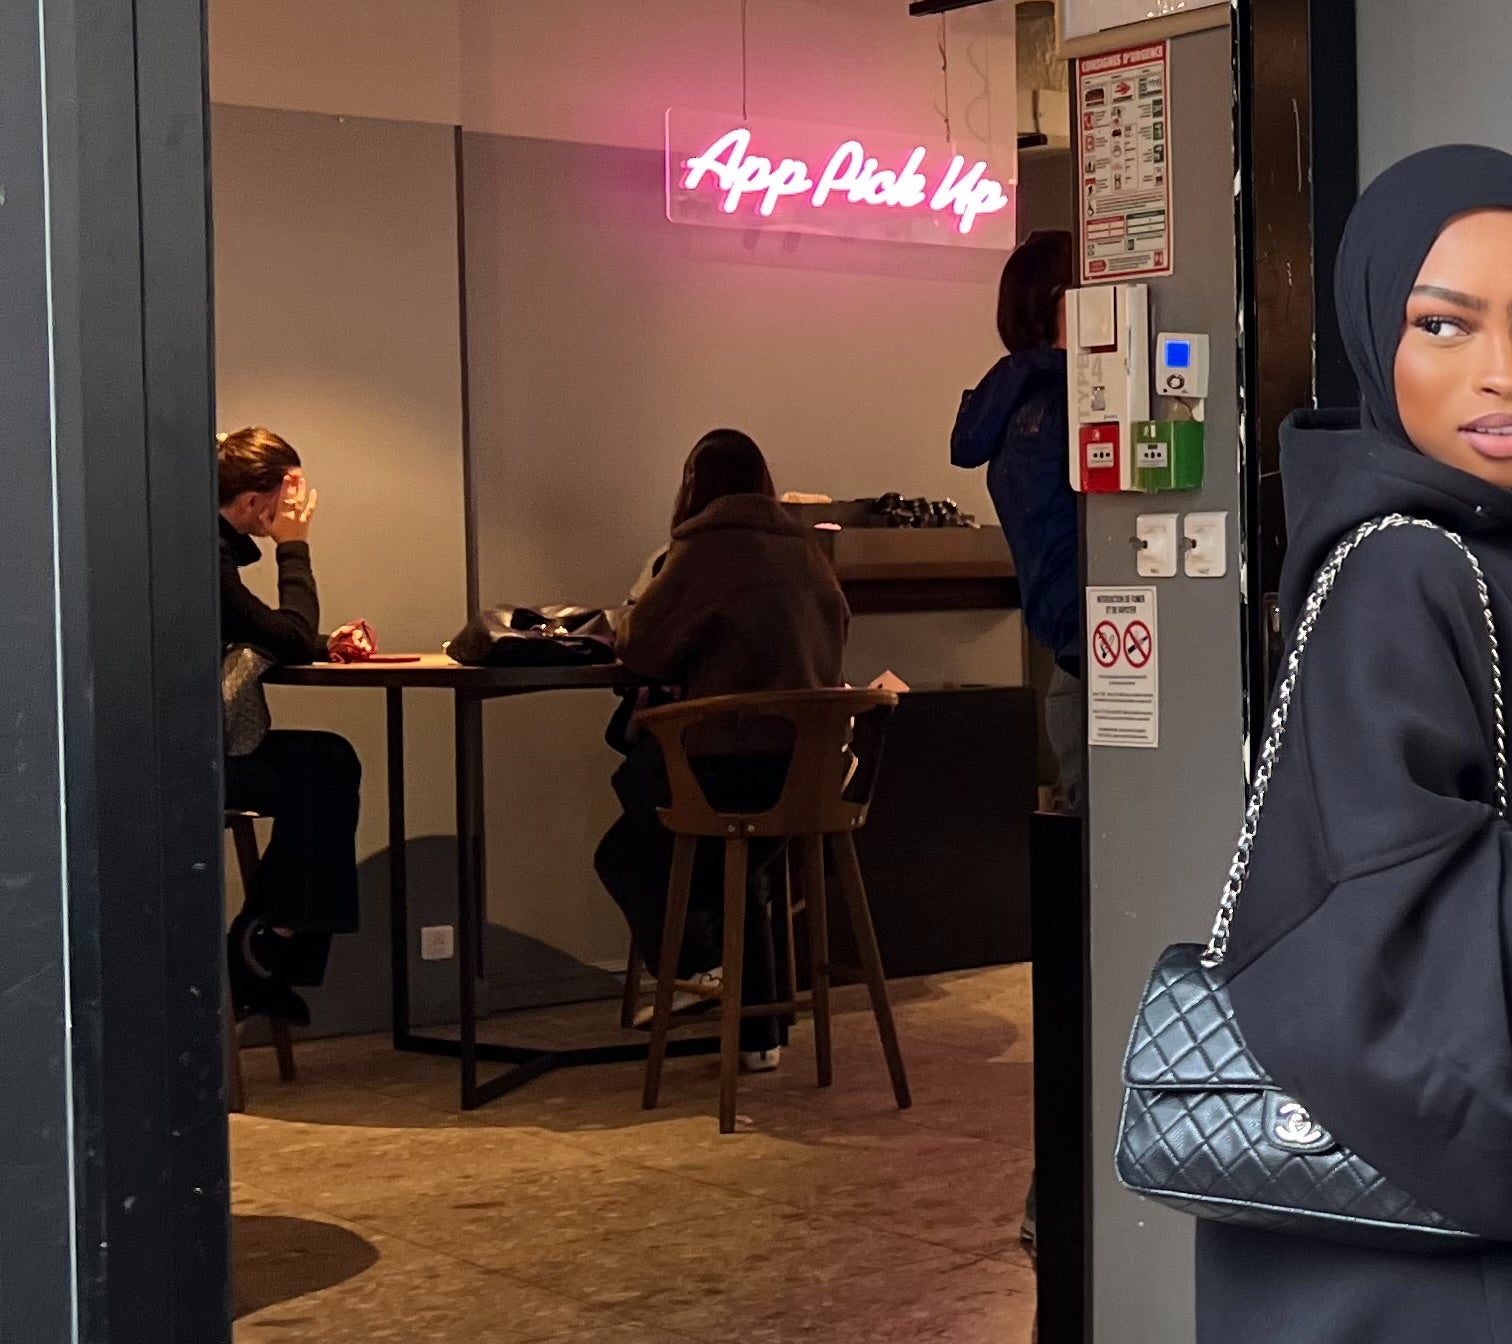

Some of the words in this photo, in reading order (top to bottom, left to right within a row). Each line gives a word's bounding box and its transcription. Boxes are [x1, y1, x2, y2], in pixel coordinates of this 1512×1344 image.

[683, 127, 813, 217] App
[811, 140, 927, 208] Pick
[929, 154, 1008, 234] Up
